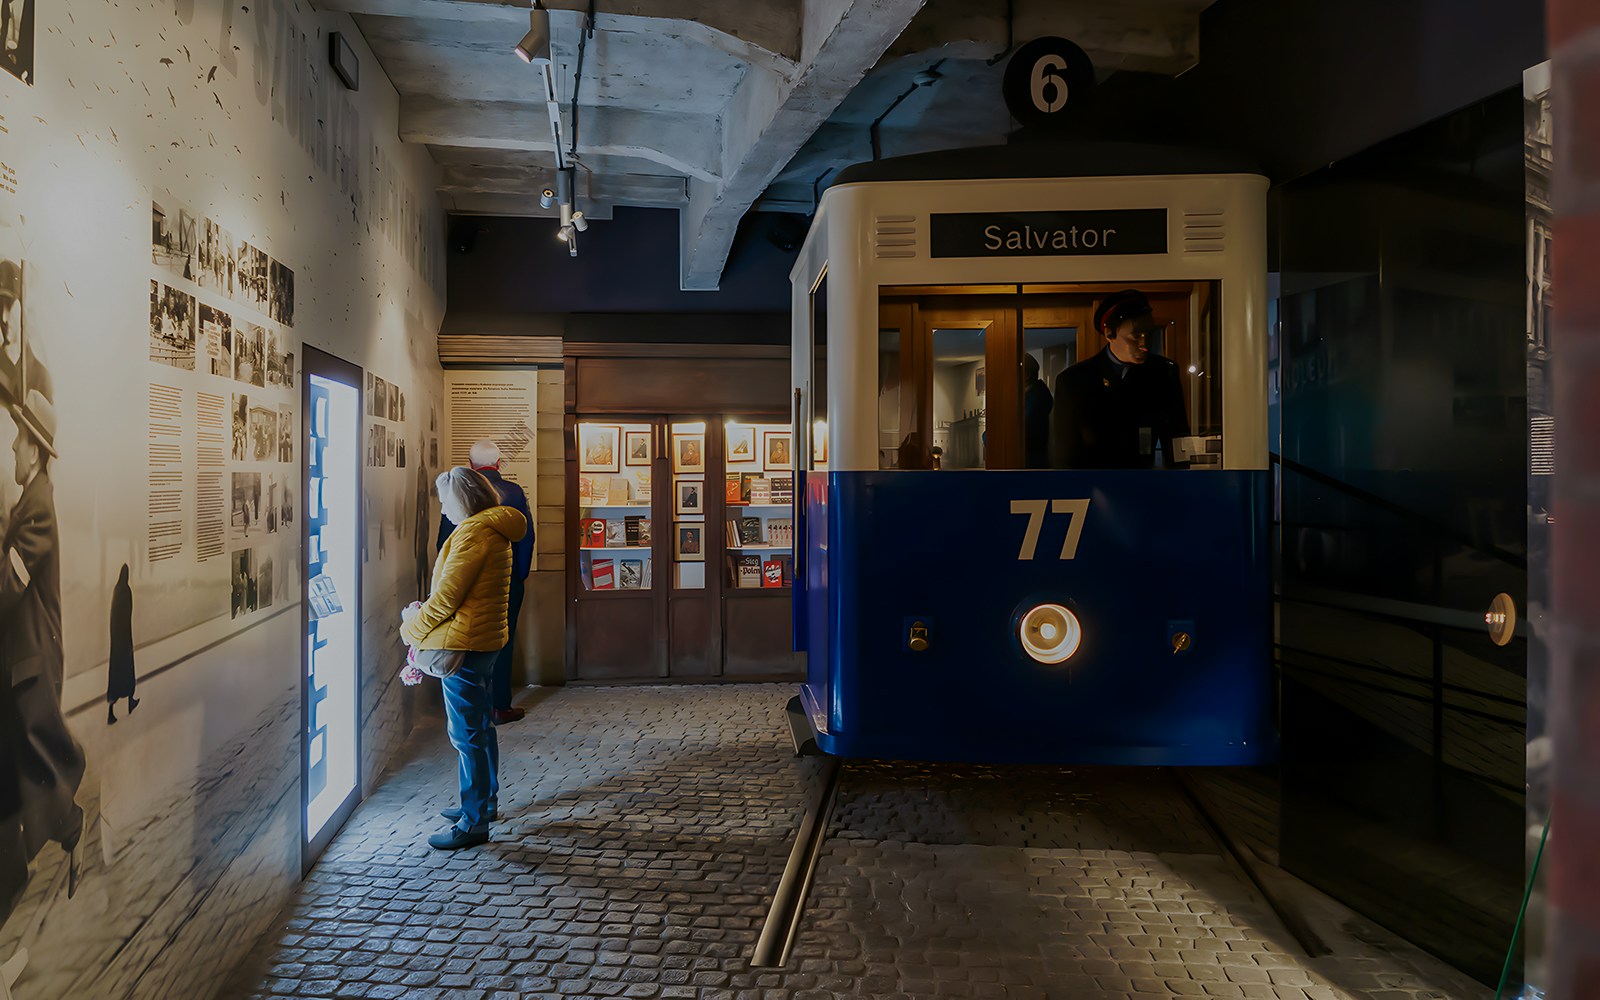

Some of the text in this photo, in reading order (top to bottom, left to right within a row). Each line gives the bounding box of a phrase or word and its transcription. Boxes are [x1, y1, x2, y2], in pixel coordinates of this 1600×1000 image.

[1029, 53, 1069, 113] 6
[983, 224, 1117, 251] Salvator
[1009, 498, 1091, 560] 77
